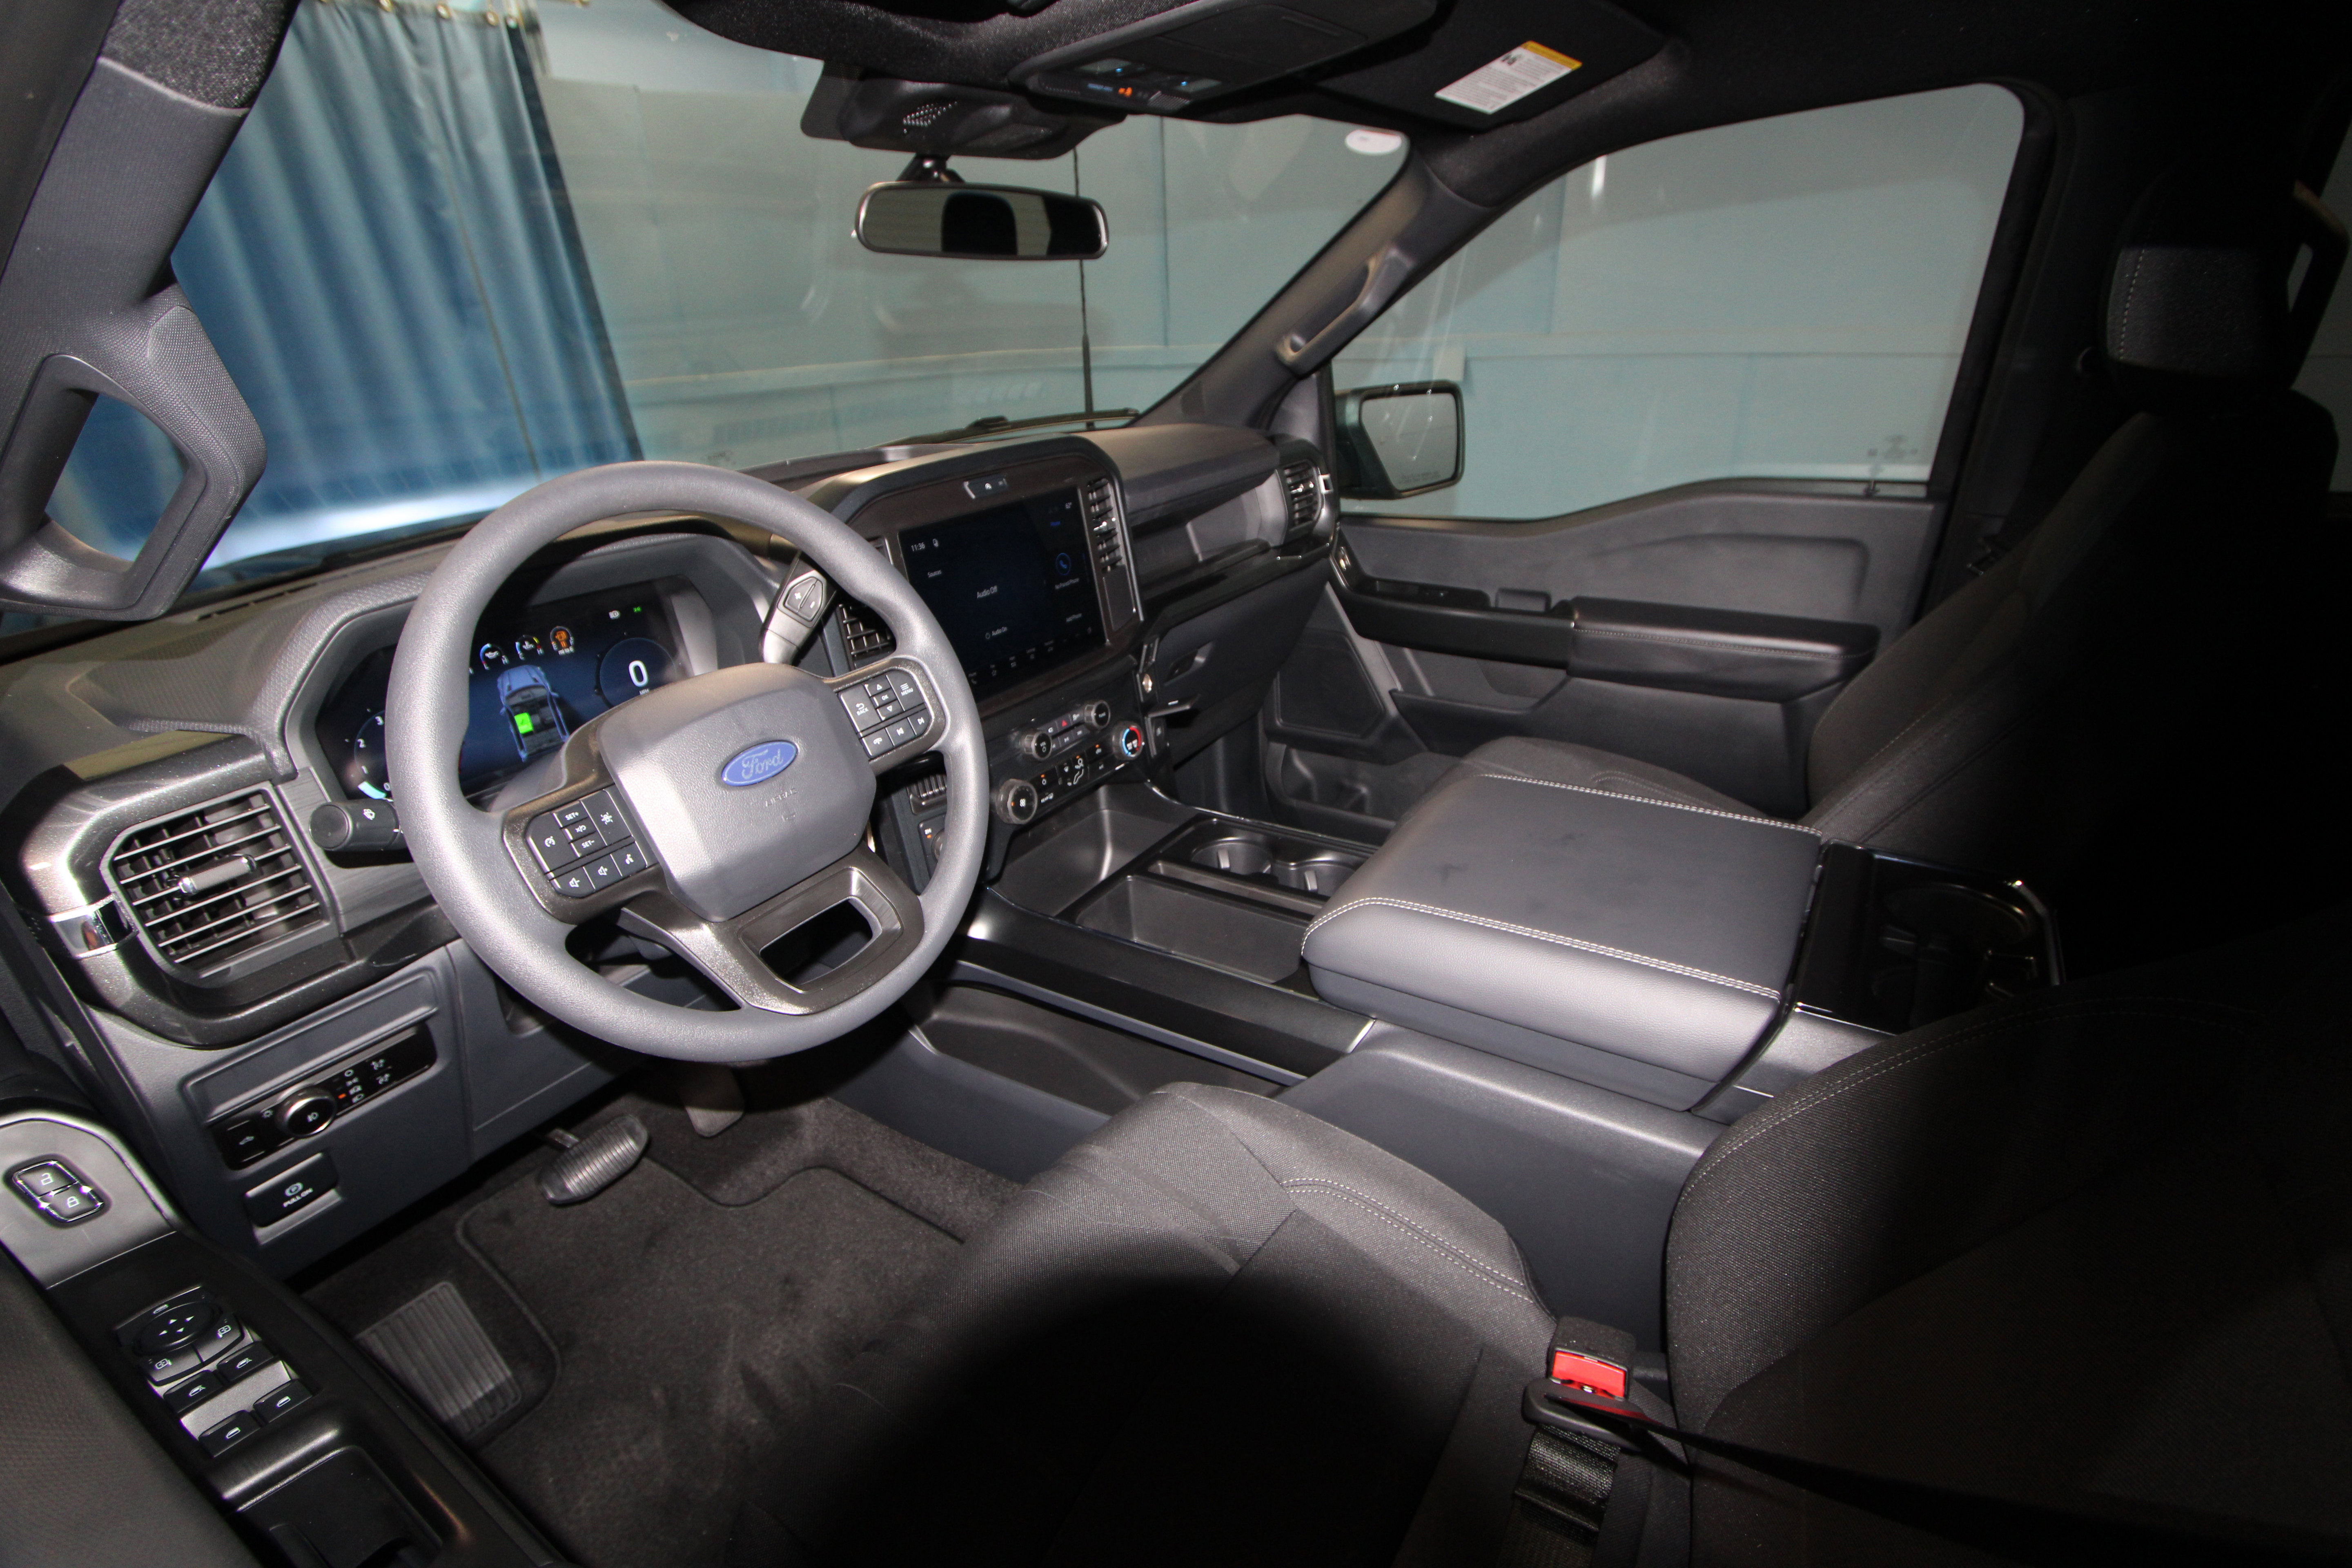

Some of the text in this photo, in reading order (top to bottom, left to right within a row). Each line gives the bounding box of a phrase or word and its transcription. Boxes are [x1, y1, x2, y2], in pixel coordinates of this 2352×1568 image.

[911, 542, 925, 552] 11:36
[927, 570, 942, 578] Sources
[977, 590, 990, 599] Audio
[628, 660, 649, 687] 0
[900, 688, 913, 696] MENU
[856, 707, 869, 716] BACK
[375, 715, 384, 726] 3
[357, 738, 366, 748] 2
[742, 748, 784, 779] Ford
[361, 765, 369, 775] 1
[383, 782, 391, 791] 0
[565, 812, 579, 821] SET+
[581, 840, 595, 849] SET-
[283, 1187, 314, 1207] PULL ON
